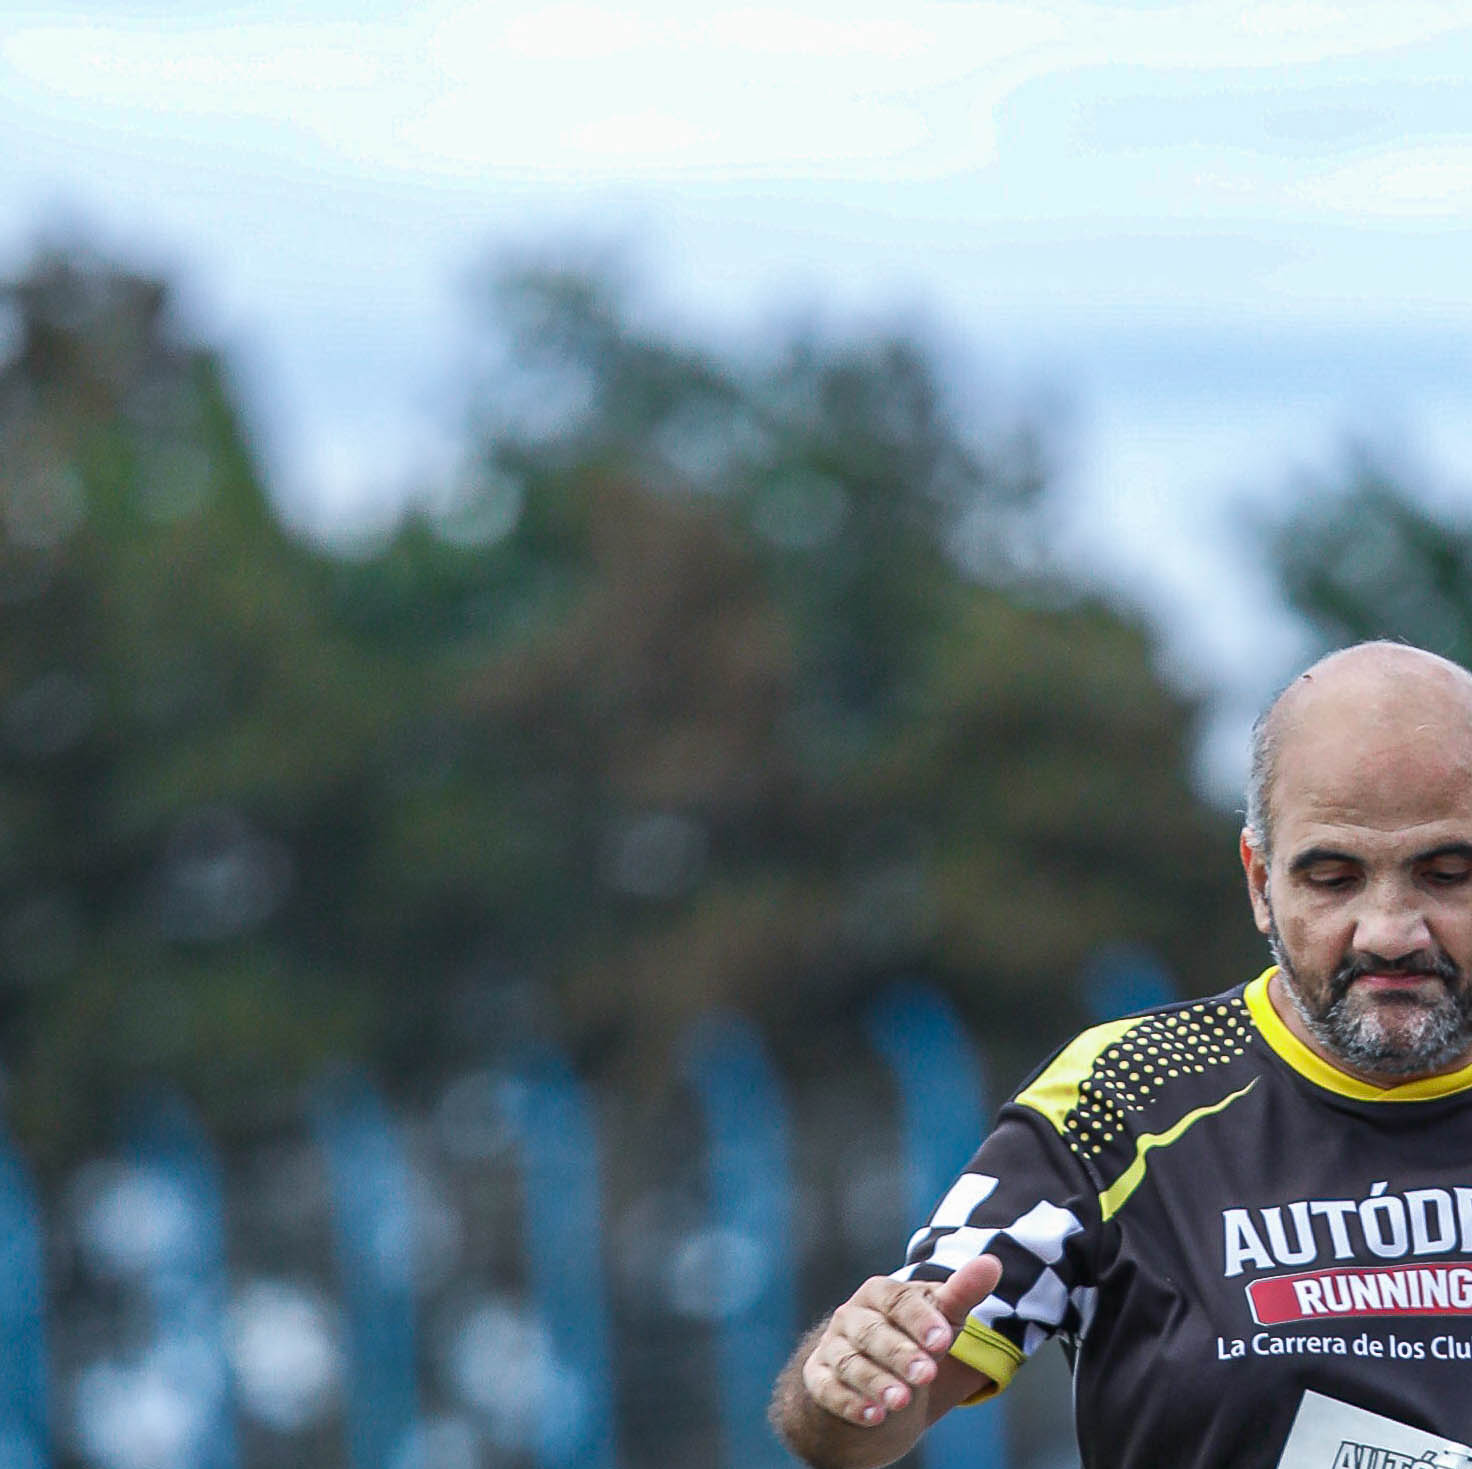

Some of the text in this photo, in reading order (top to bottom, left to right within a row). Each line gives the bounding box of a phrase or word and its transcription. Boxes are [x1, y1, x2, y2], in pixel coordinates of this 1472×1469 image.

[1217, 1336, 1245, 1360] La
[1252, 1332, 1347, 1356] Carrera
[1352, 1333, 1384, 1358] de
[1389, 1334, 1425, 1359] los
